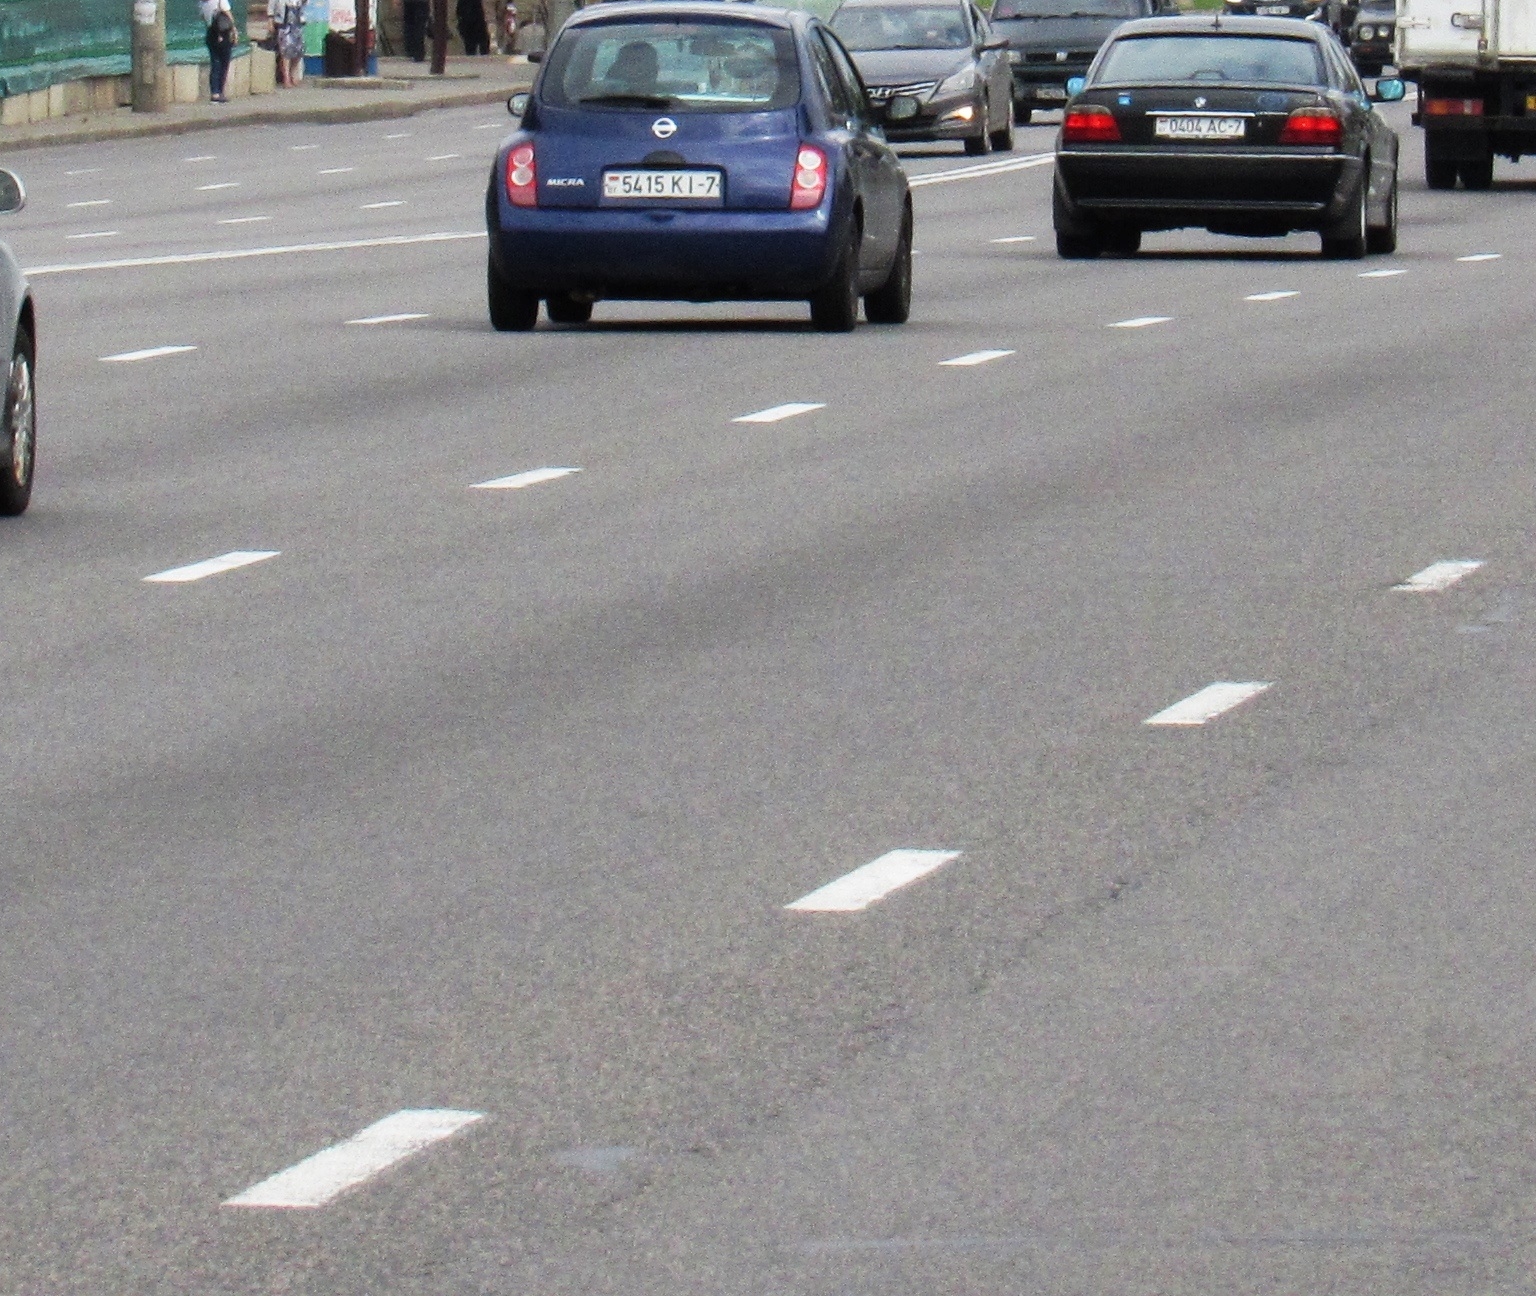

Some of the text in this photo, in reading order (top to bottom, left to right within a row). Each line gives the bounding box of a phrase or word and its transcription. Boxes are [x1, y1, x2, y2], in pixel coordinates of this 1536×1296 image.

[1169, 118, 1243, 134] 0404 AC-7
[546, 177, 585, 187] MICRA
[621, 175, 666, 194] 5415
